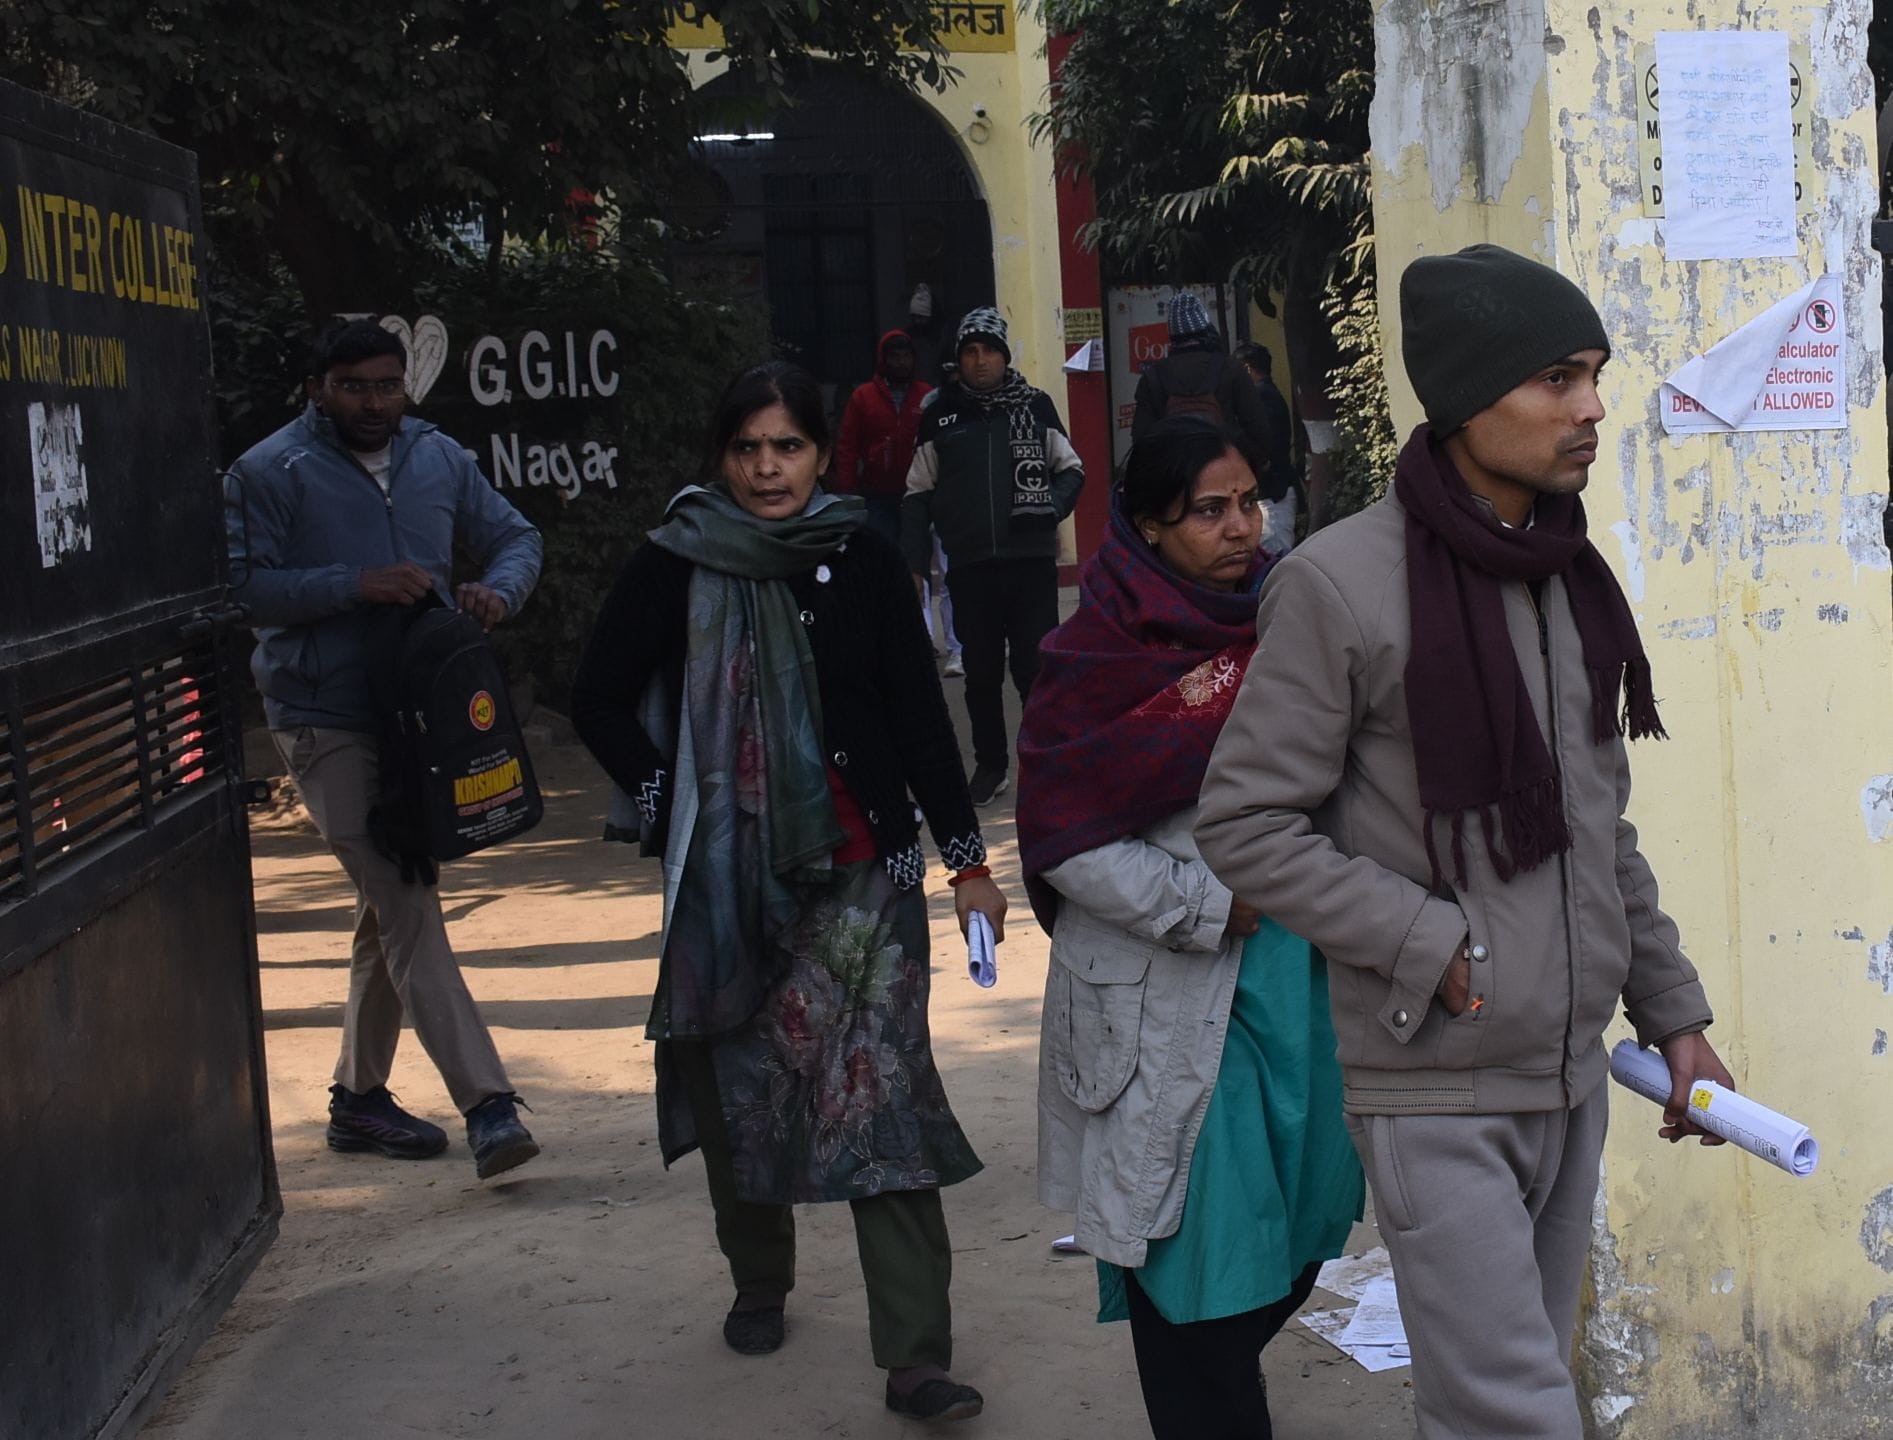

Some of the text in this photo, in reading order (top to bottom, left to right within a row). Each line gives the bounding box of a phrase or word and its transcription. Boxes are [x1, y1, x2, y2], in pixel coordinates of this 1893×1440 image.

[17, 184, 105, 295] INTER
[108, 210, 200, 311] COLLEGE
[0, 323, 12, 383] S
[18, 326, 64, 386] NAGAR
[469, 329, 620, 406] G.G.I.C
[1765, 366, 1835, 385] Electronic
[1775, 341, 1840, 359] alculator
[1762, 391, 1835, 411] ALLOWED
[491, 432, 618, 501] Nagar
